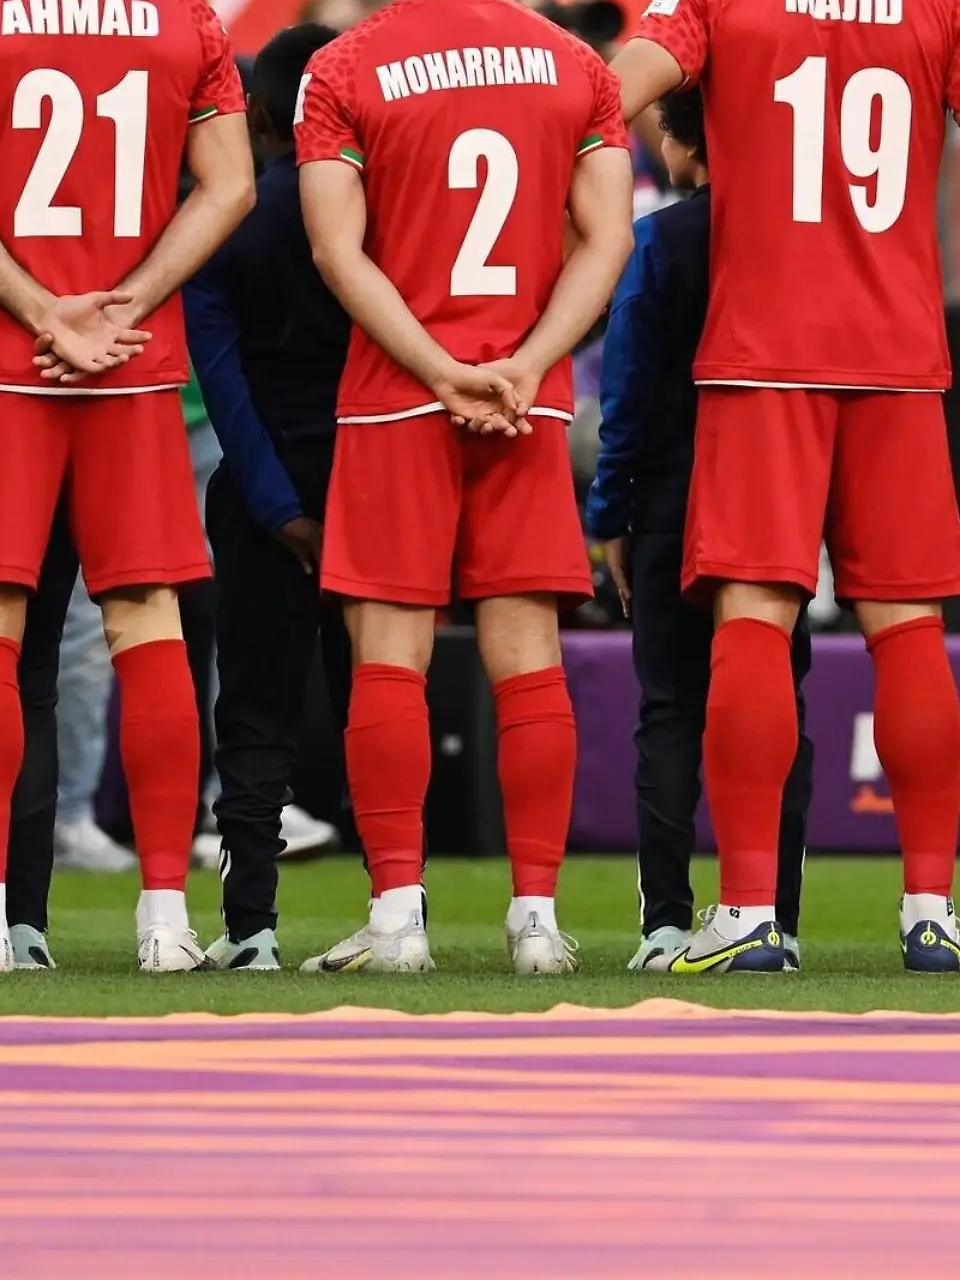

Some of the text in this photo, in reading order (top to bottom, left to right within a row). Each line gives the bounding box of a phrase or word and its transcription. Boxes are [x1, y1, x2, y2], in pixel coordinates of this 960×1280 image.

[12, 68, 149, 237] 21
[376, 46, 558, 102] MOHARRAMI
[773, 56, 912, 233] 19
[448, 128, 519, 296] 2
